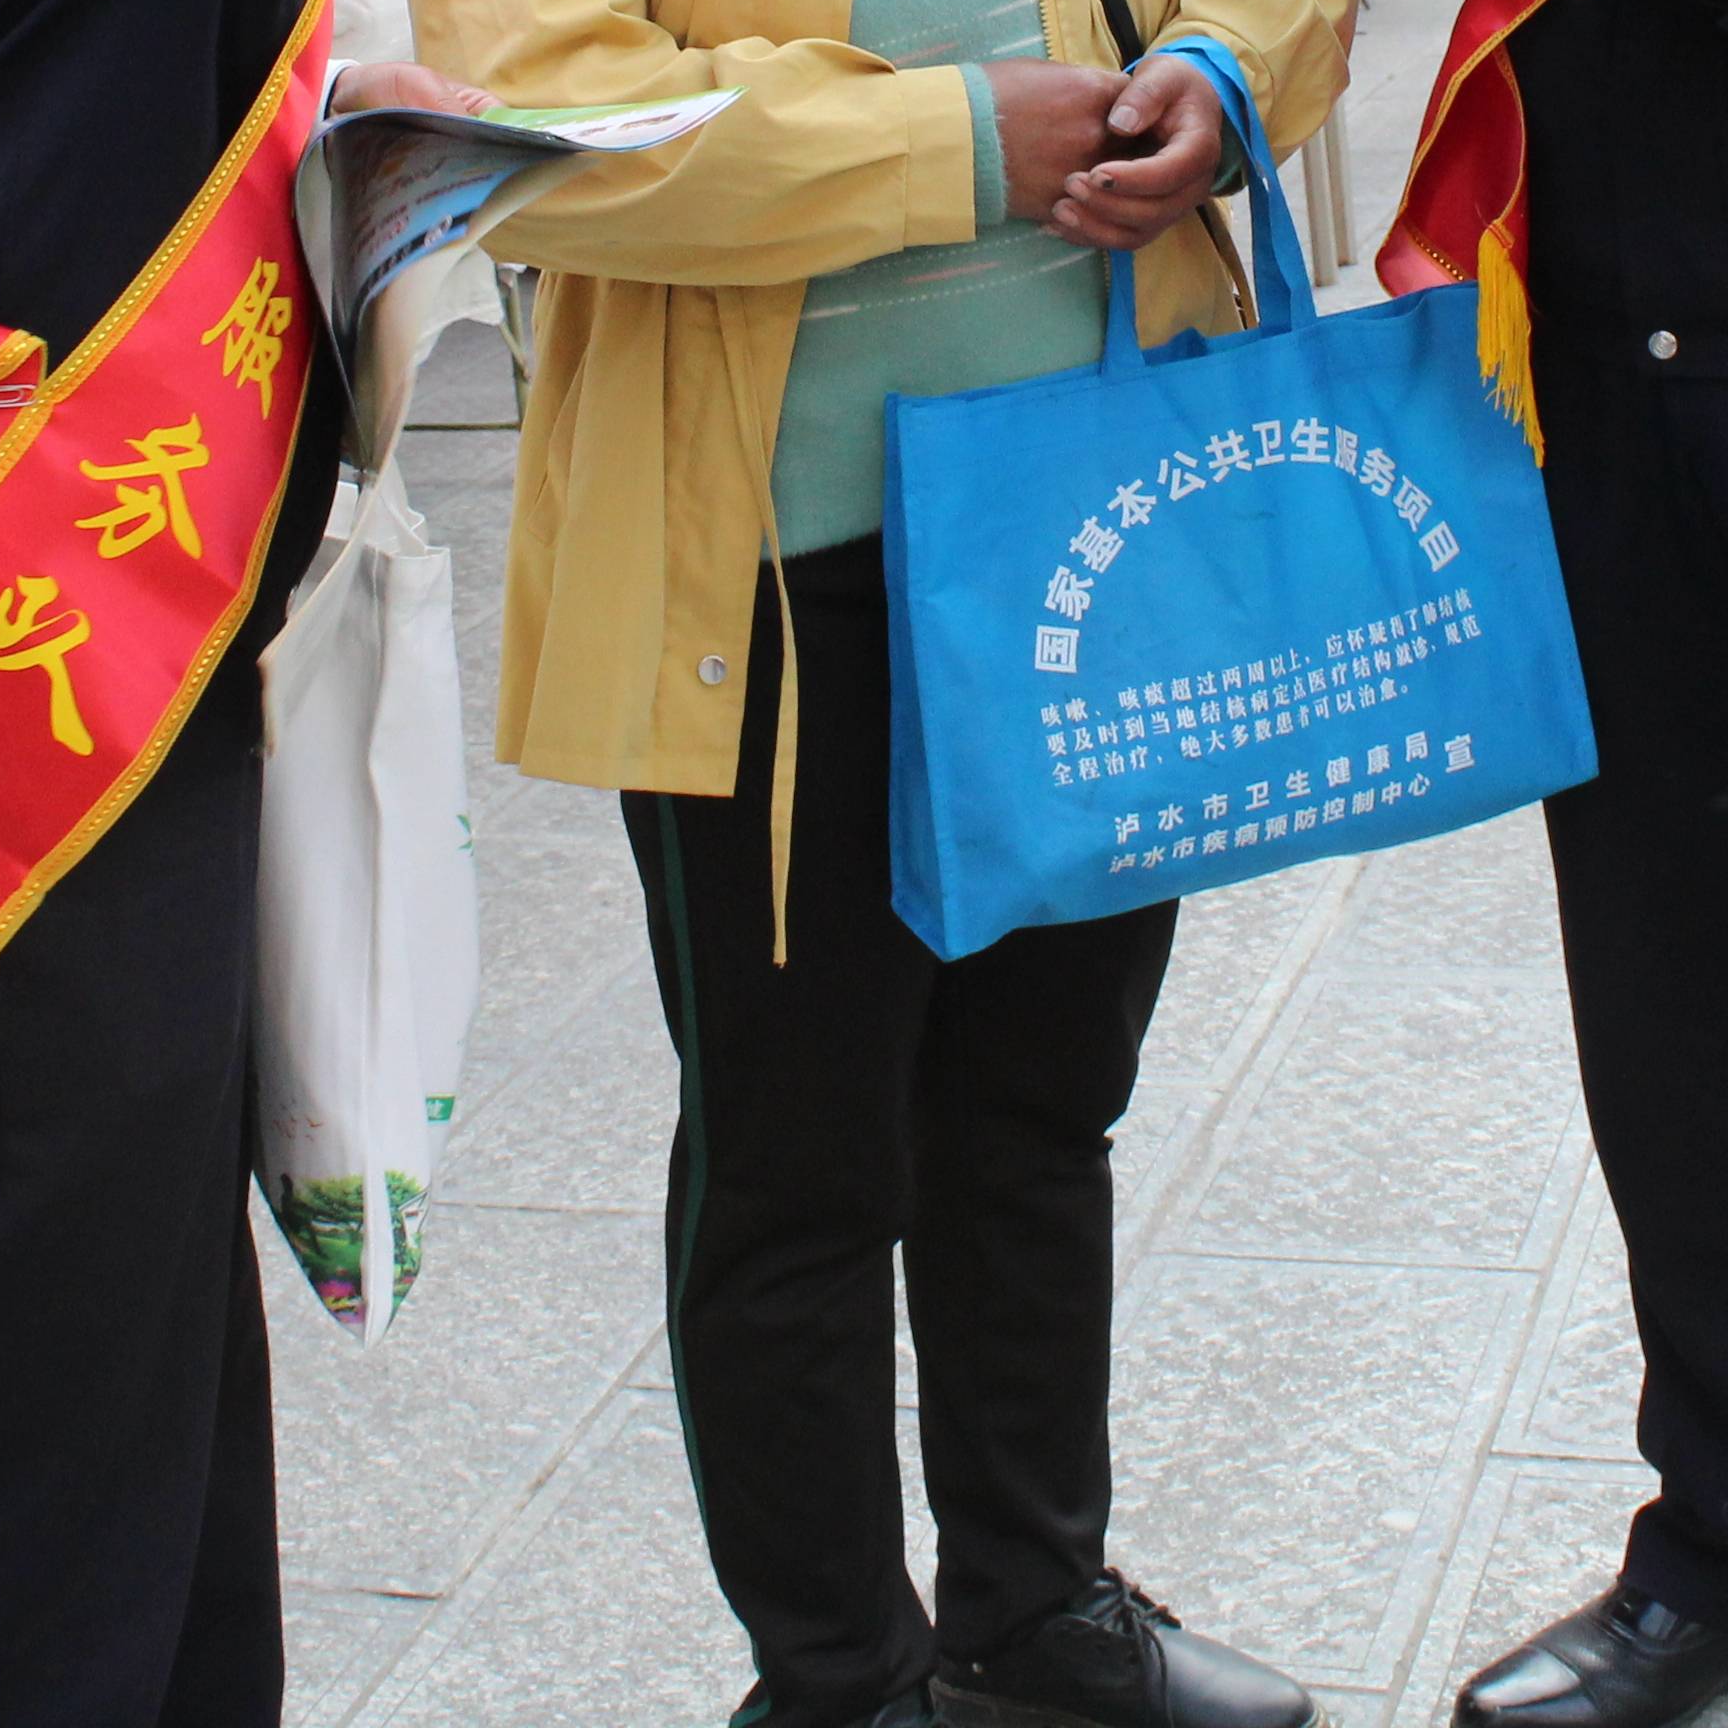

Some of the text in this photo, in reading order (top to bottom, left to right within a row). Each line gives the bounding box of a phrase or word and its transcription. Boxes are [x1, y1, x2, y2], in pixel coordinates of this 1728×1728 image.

[1034, 417, 1460, 673] 国家基本公共卫生服务项目
[1108, 772, 1432, 874] 泸水市疾病预防控制中心
[1114, 730, 1429, 845] 泸水市卫生健康局
